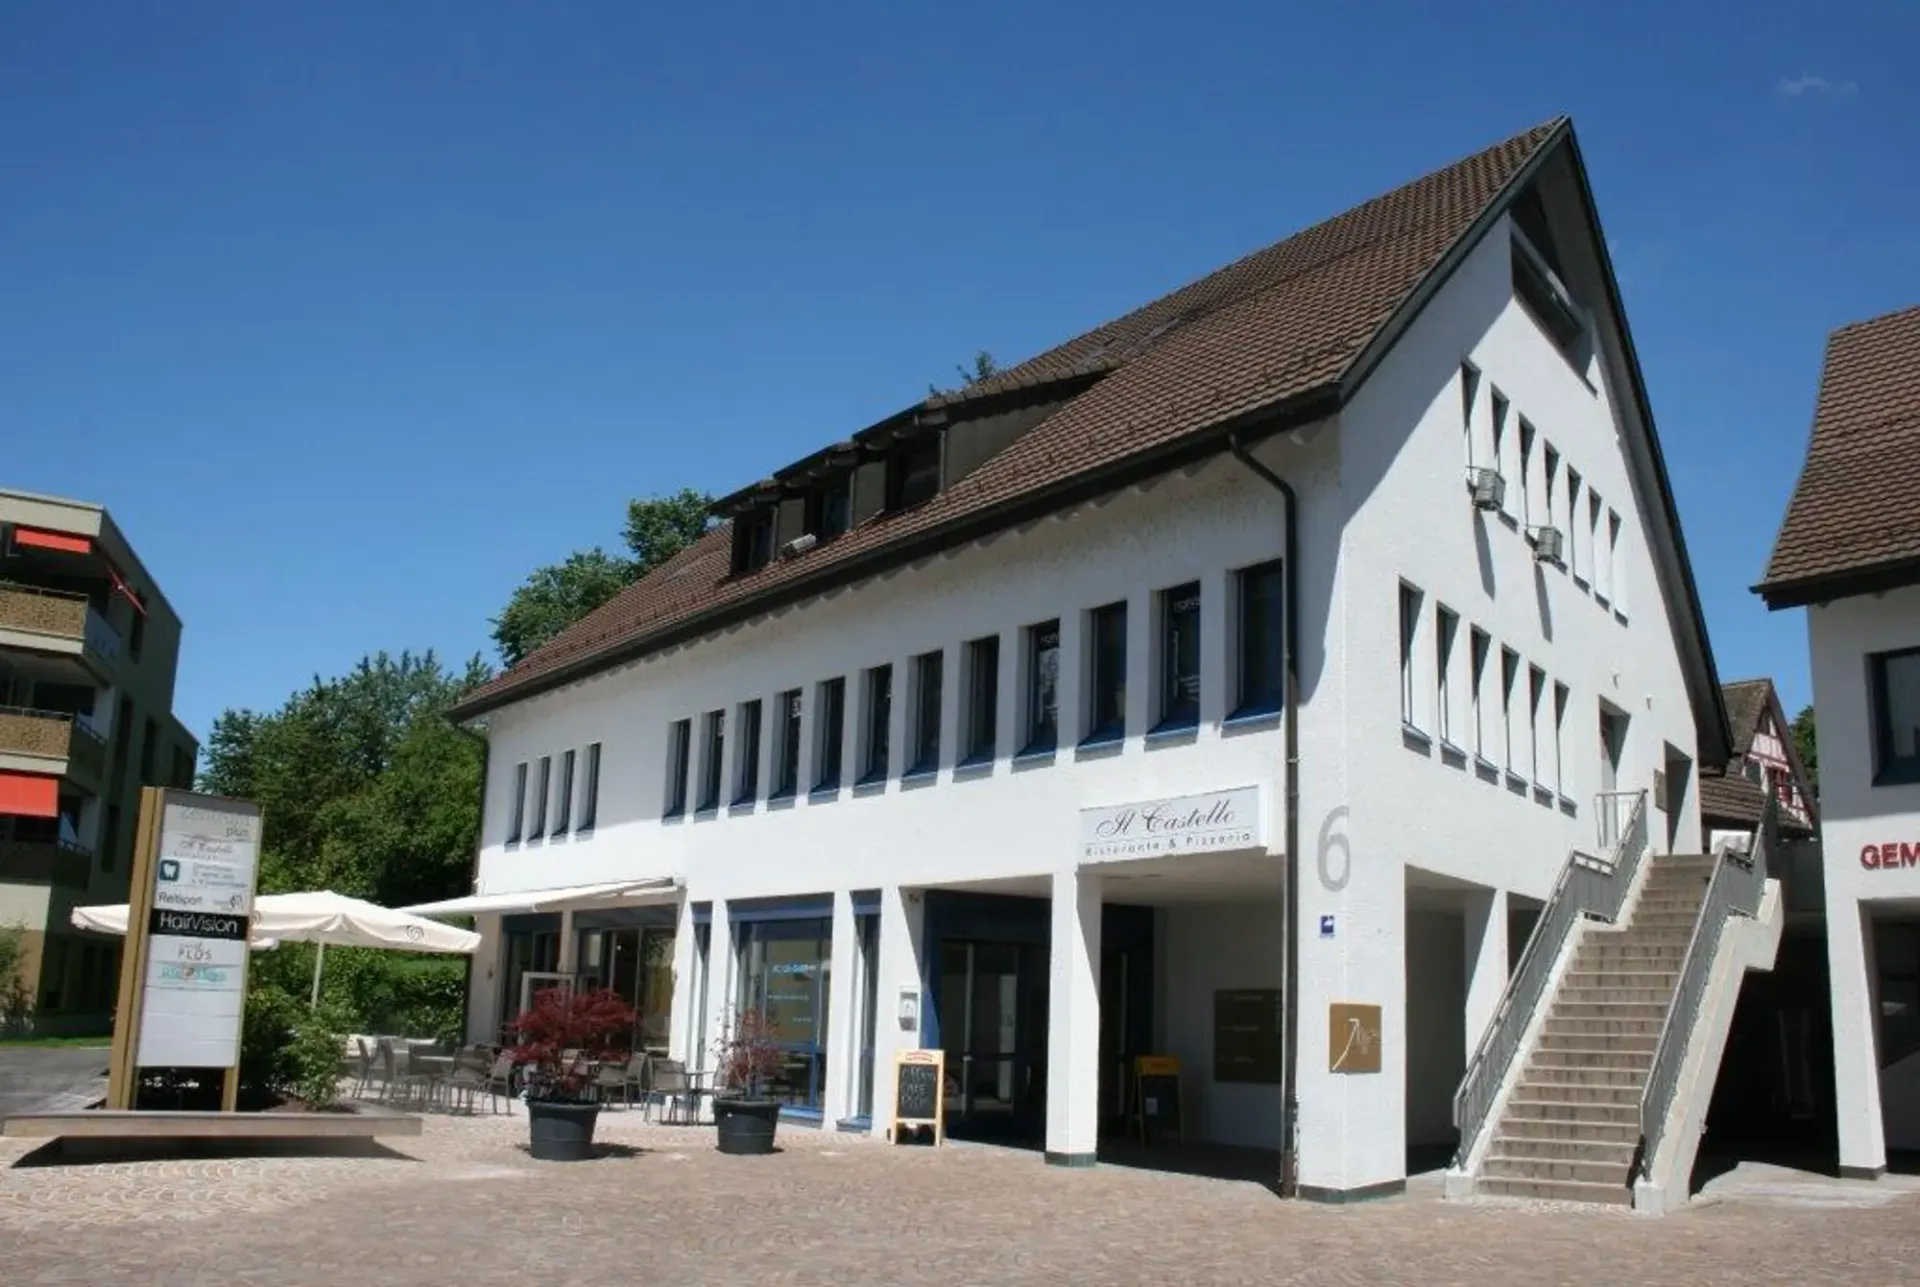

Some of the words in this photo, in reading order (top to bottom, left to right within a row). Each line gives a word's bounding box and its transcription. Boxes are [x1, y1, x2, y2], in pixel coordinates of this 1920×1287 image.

[1141, 798, 1235, 833] Castello
[1317, 805, 1350, 893] 6
[159, 911, 238, 934] HairVision
